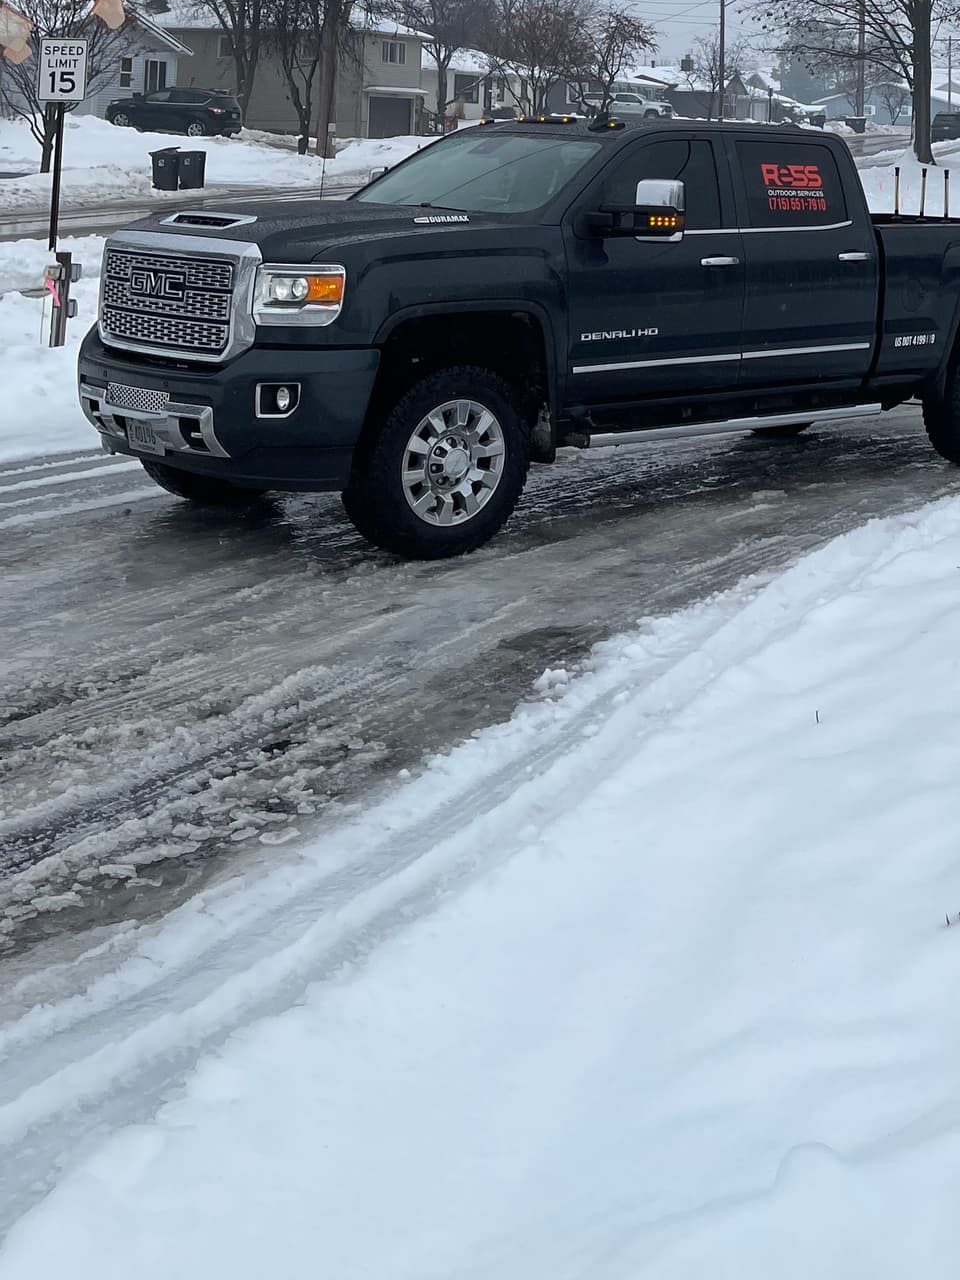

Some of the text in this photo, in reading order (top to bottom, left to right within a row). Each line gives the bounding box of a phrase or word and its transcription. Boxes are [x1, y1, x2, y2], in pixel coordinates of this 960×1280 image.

[44, 45, 84, 56] SPEED
[47, 58, 79, 69] LIMIT
[49, 71, 76, 94] 15
[767, 189, 824, 198] OUTDOOR SERVICES
[768, 197, 790, 211] (715)
[429, 215, 470, 223] DURAMAX
[130, 270, 184, 297] GMC
[580, 327, 659, 341] DENALI HD
